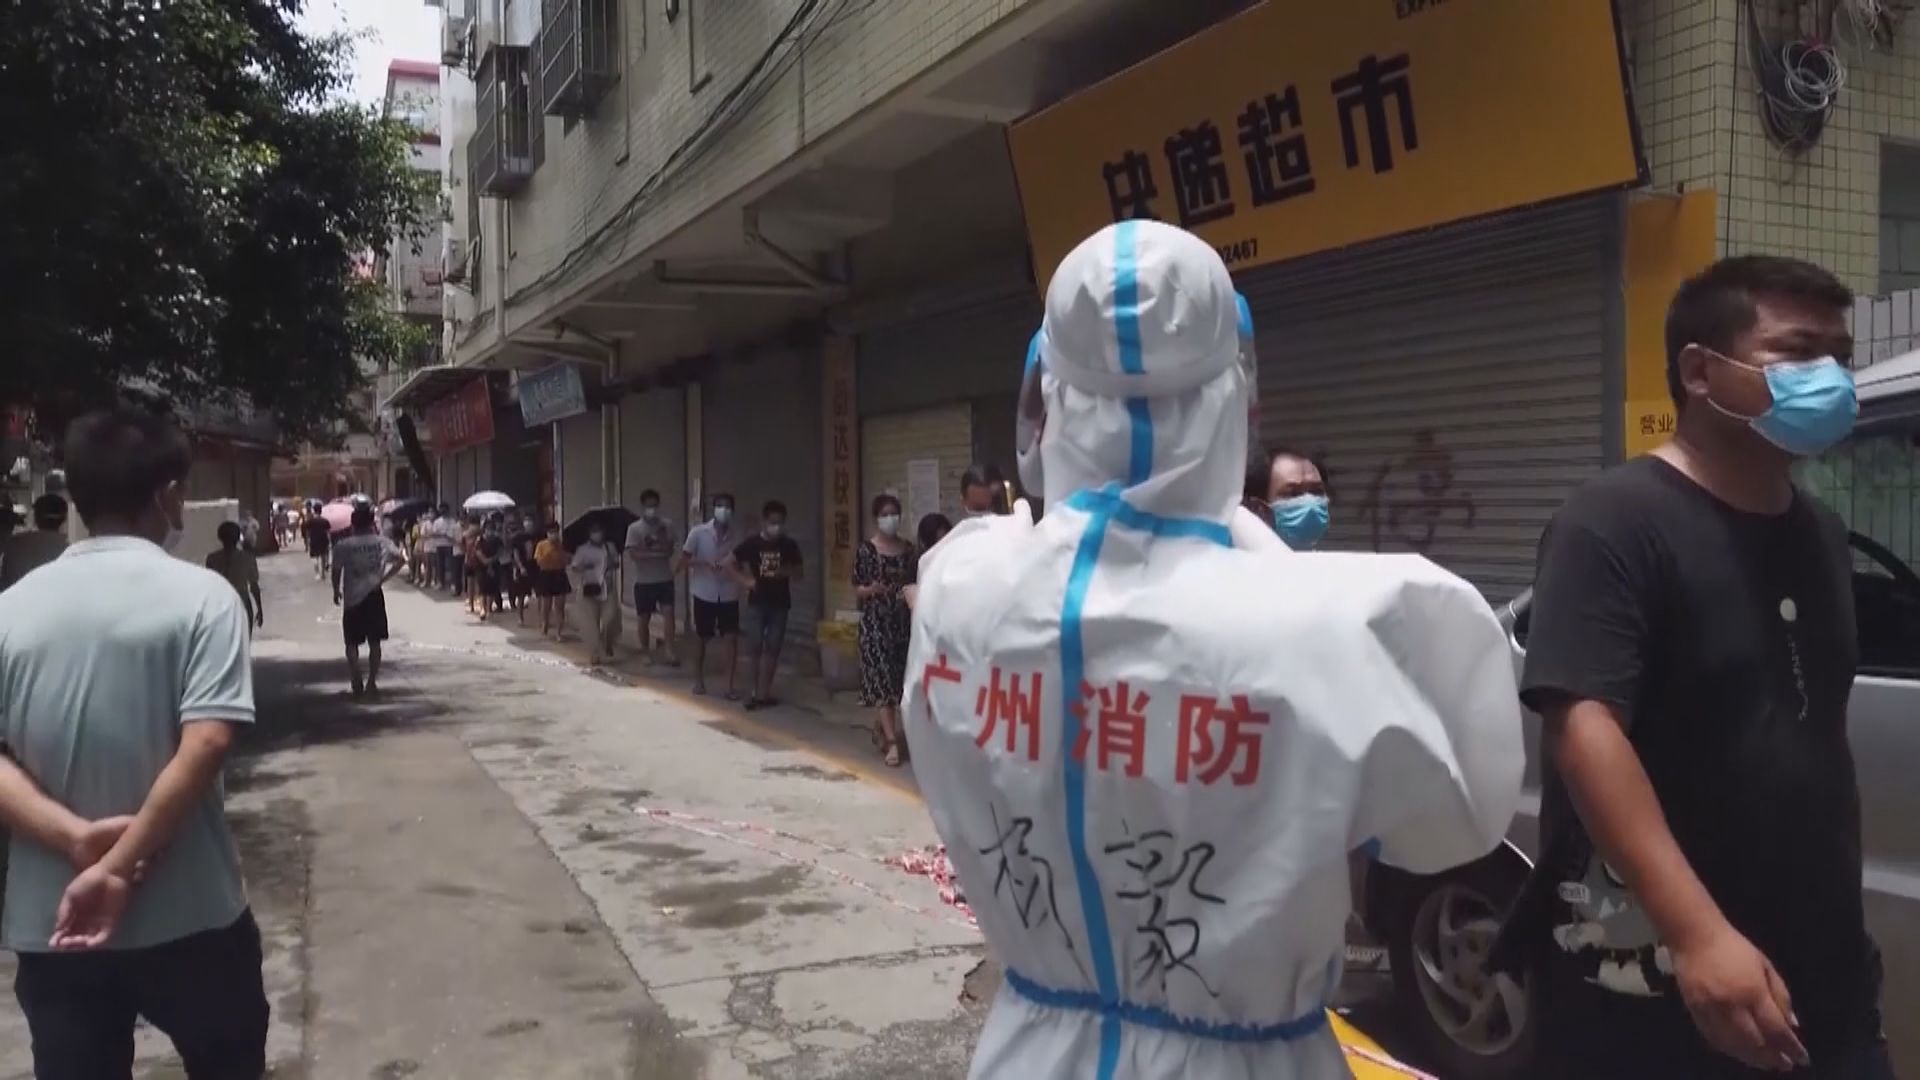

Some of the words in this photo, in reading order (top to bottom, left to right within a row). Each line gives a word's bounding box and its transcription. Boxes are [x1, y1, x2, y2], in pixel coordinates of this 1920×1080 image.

[1103, 53, 1418, 226] 快递超市
[922, 653, 1270, 786] 广州消防
